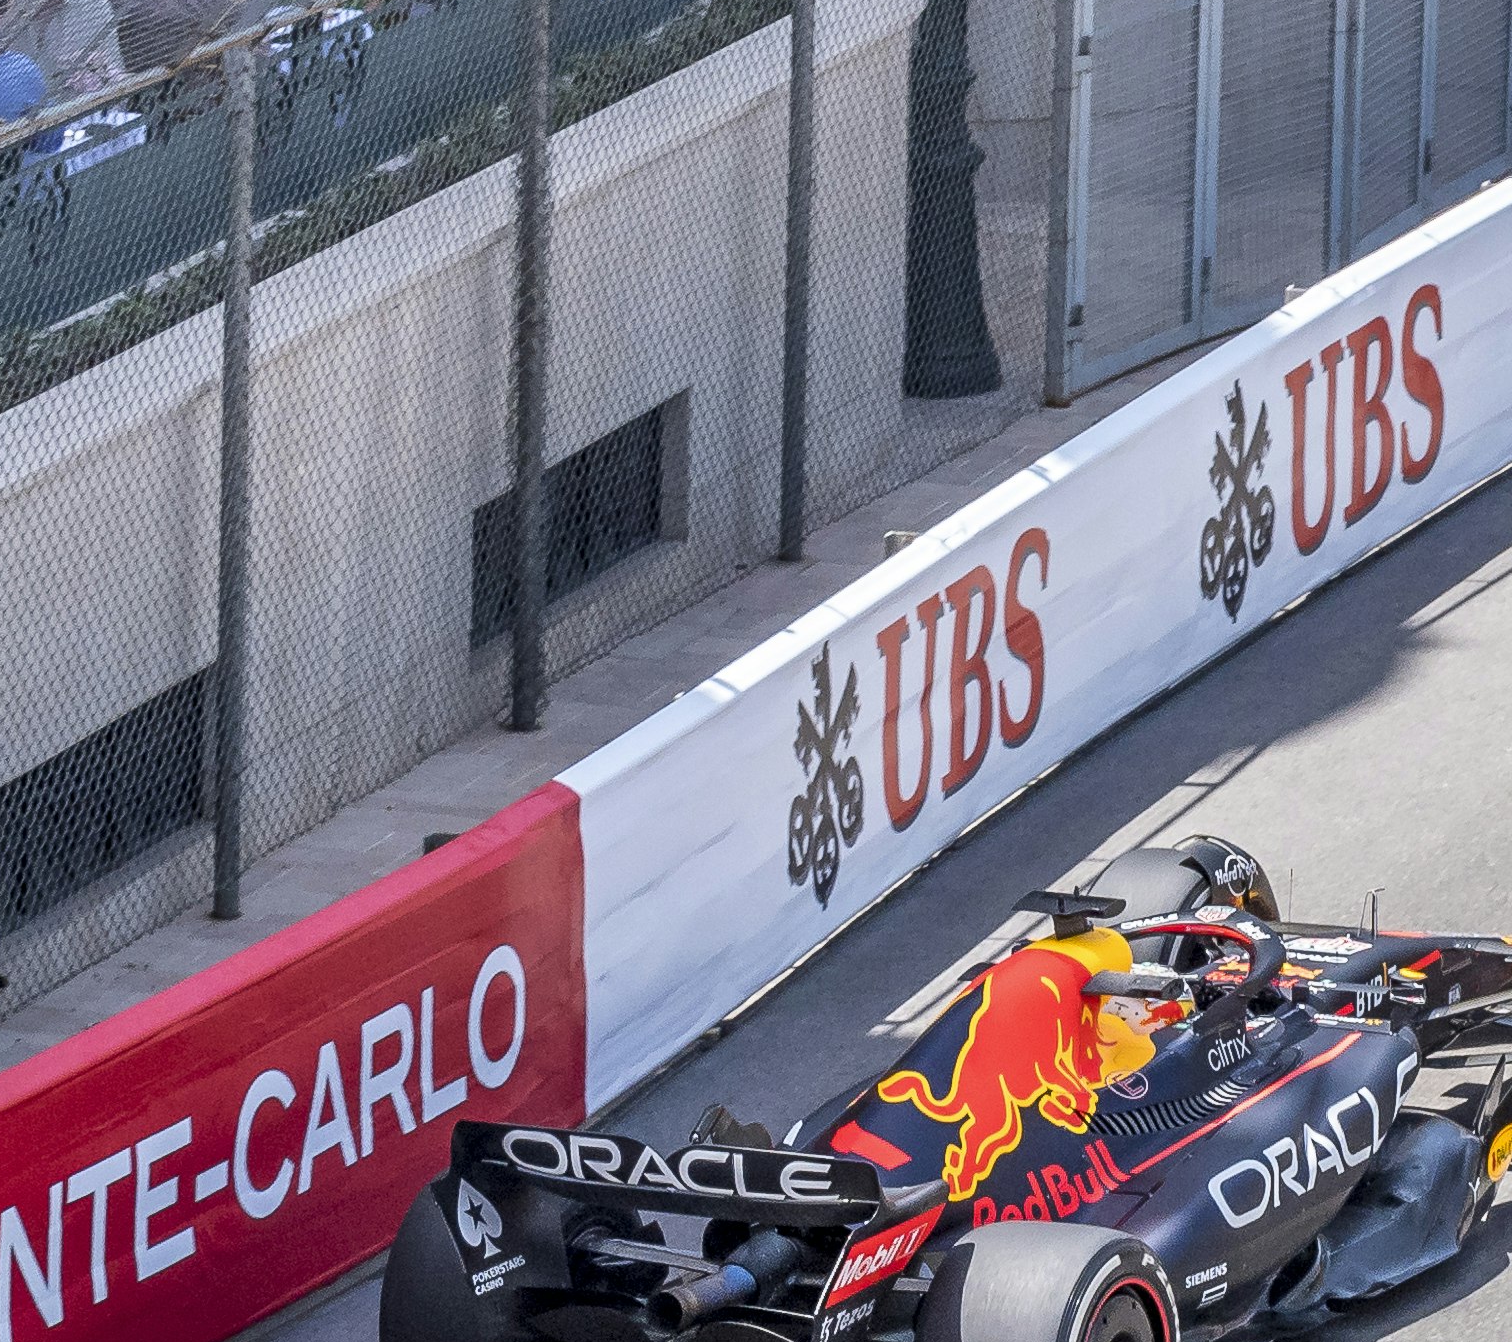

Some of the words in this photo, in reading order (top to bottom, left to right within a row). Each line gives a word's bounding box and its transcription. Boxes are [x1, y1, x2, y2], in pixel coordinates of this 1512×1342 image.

[1284, 281, 1446, 556] UBS
[876, 525, 1050, 833] UBS
[1207, 1029, 1251, 1072] citrix
[501, 1128, 841, 1202] ORACLE
[472, 1254, 526, 1287] POKERSTARS
[832, 1233, 905, 1293] Mobil
[1185, 1261, 1229, 1290] SIEMENS
[474, 1276, 504, 1296] CASINO
[833, 1297, 876, 1336] Tezos
